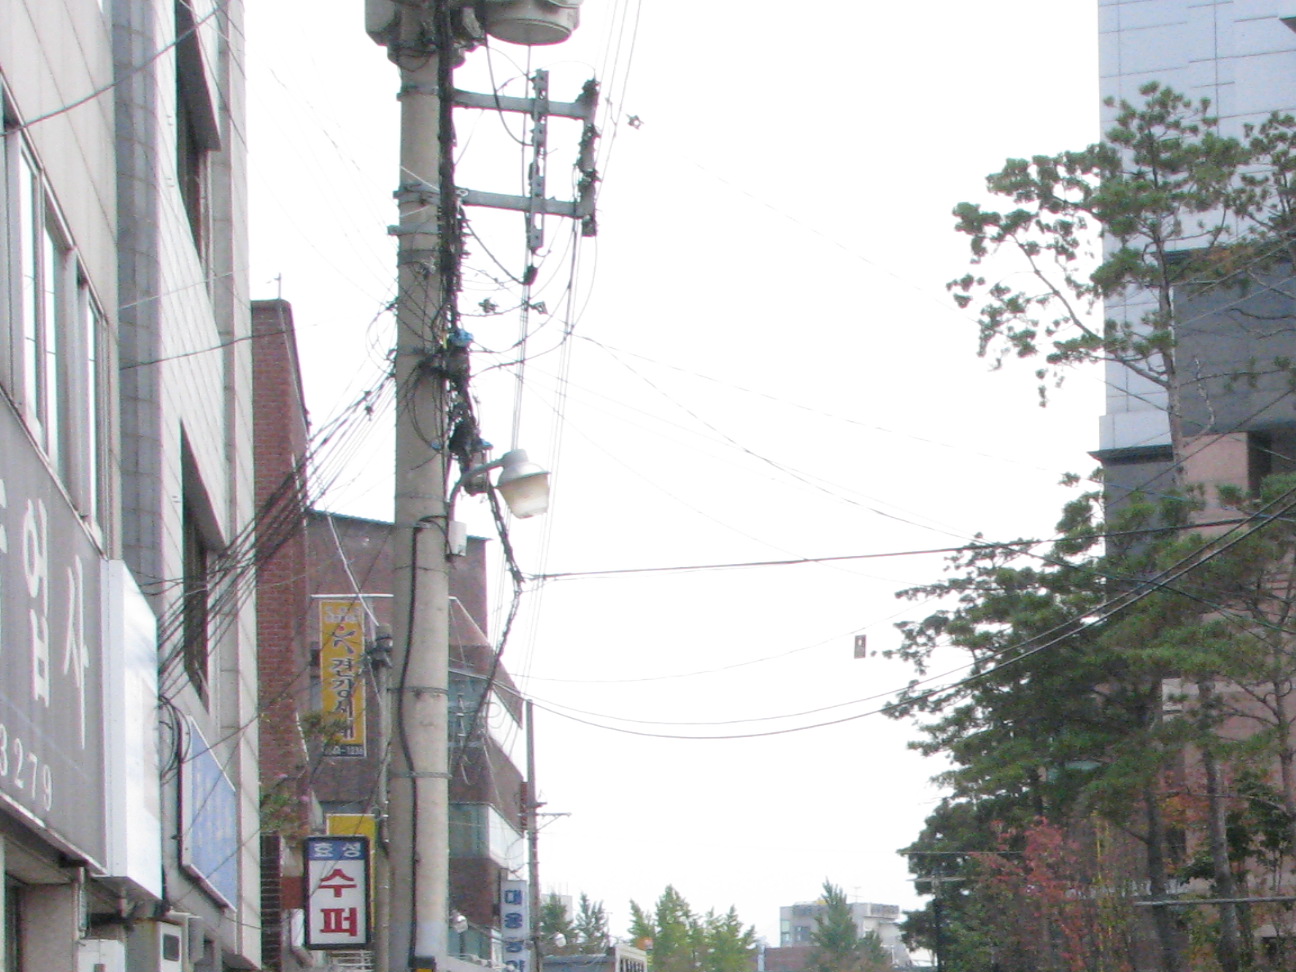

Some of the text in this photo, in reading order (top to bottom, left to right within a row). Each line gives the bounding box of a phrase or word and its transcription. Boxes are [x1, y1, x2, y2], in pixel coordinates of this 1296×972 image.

[0, 477, 89, 749] 업사
[313, 842, 362, 858] 효성
[317, 868, 358, 937] 수퍼
